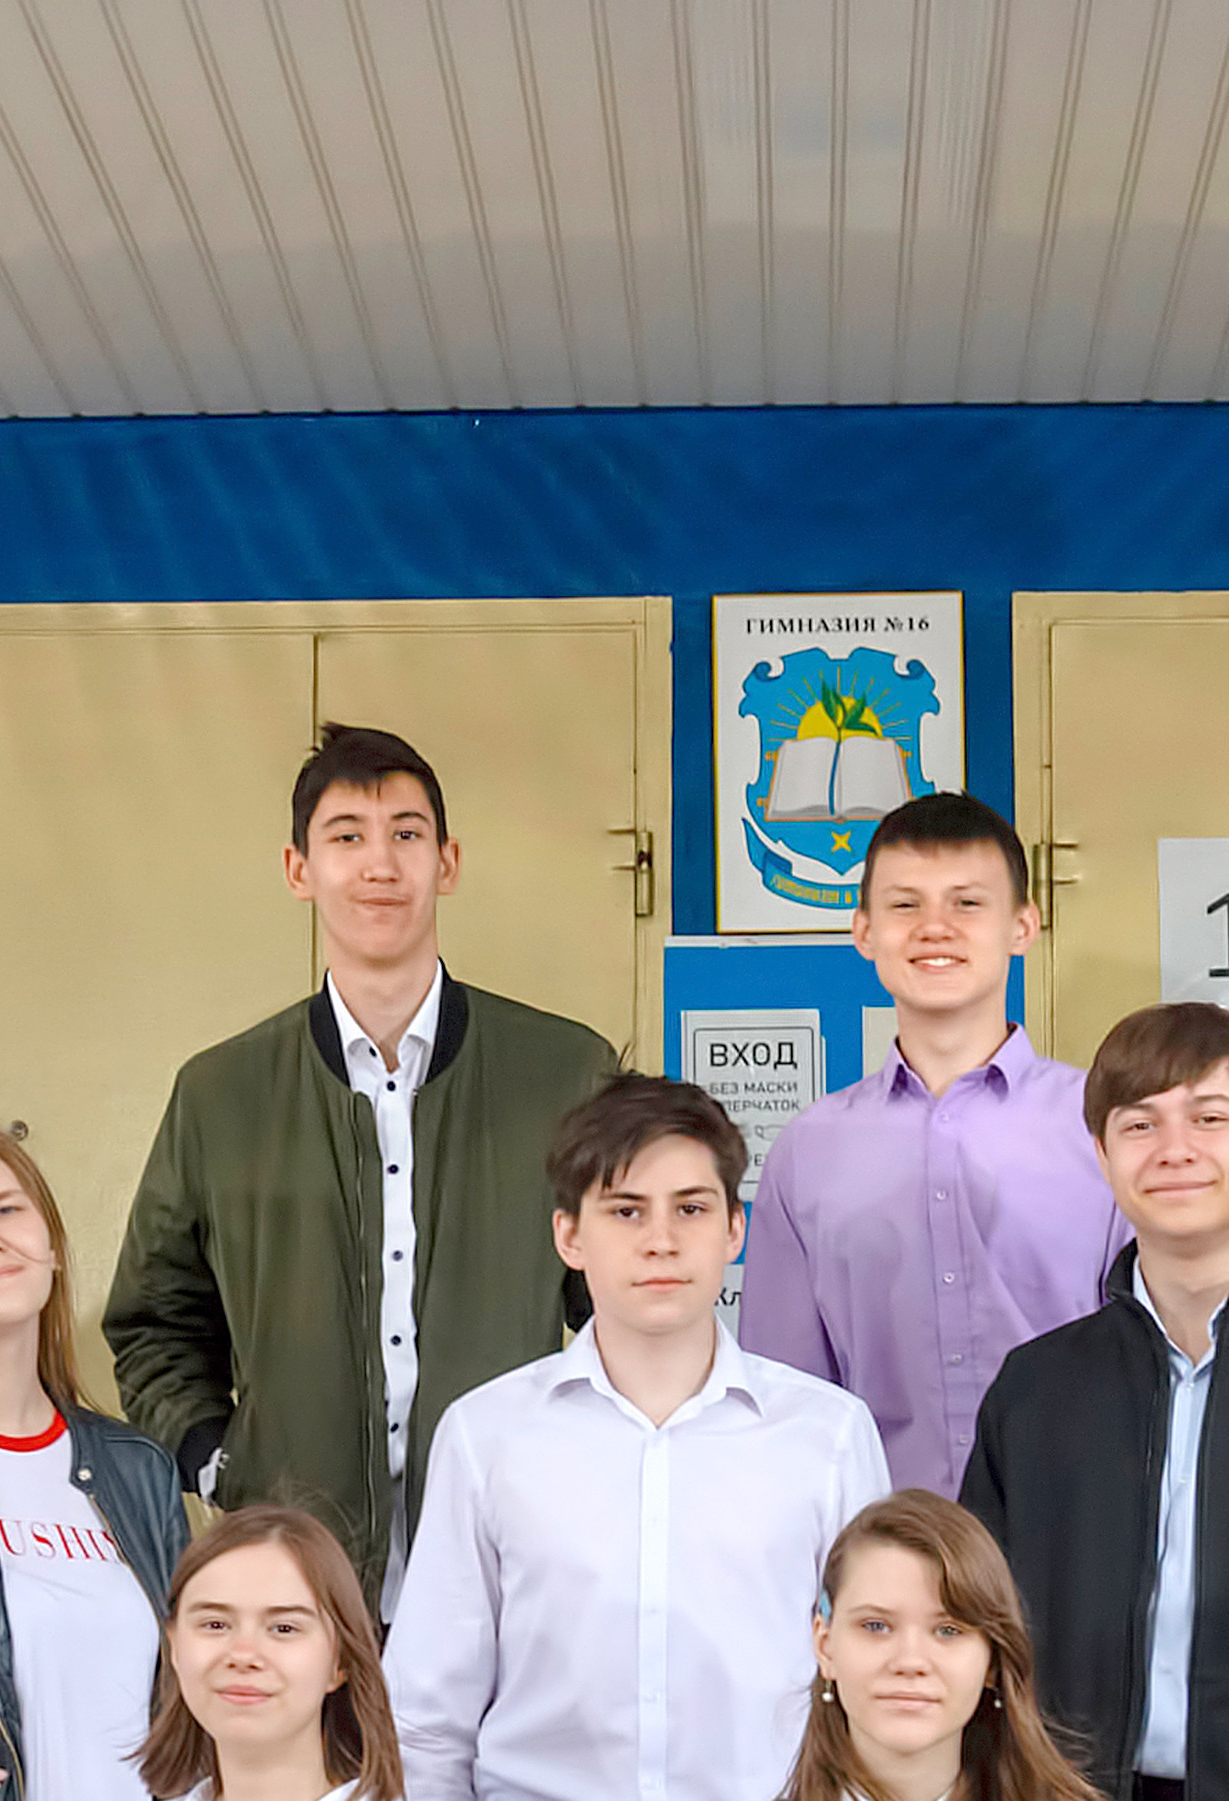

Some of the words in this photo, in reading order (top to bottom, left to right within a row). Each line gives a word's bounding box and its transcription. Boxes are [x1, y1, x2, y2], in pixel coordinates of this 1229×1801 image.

[746, 616, 876, 635] ГИМНАЗИЯ
[709, 1041, 798, 1070] ВХОД
[709, 1081, 739, 1095] БЕЗ
[744, 1080, 798, 1094] МАСКИ
